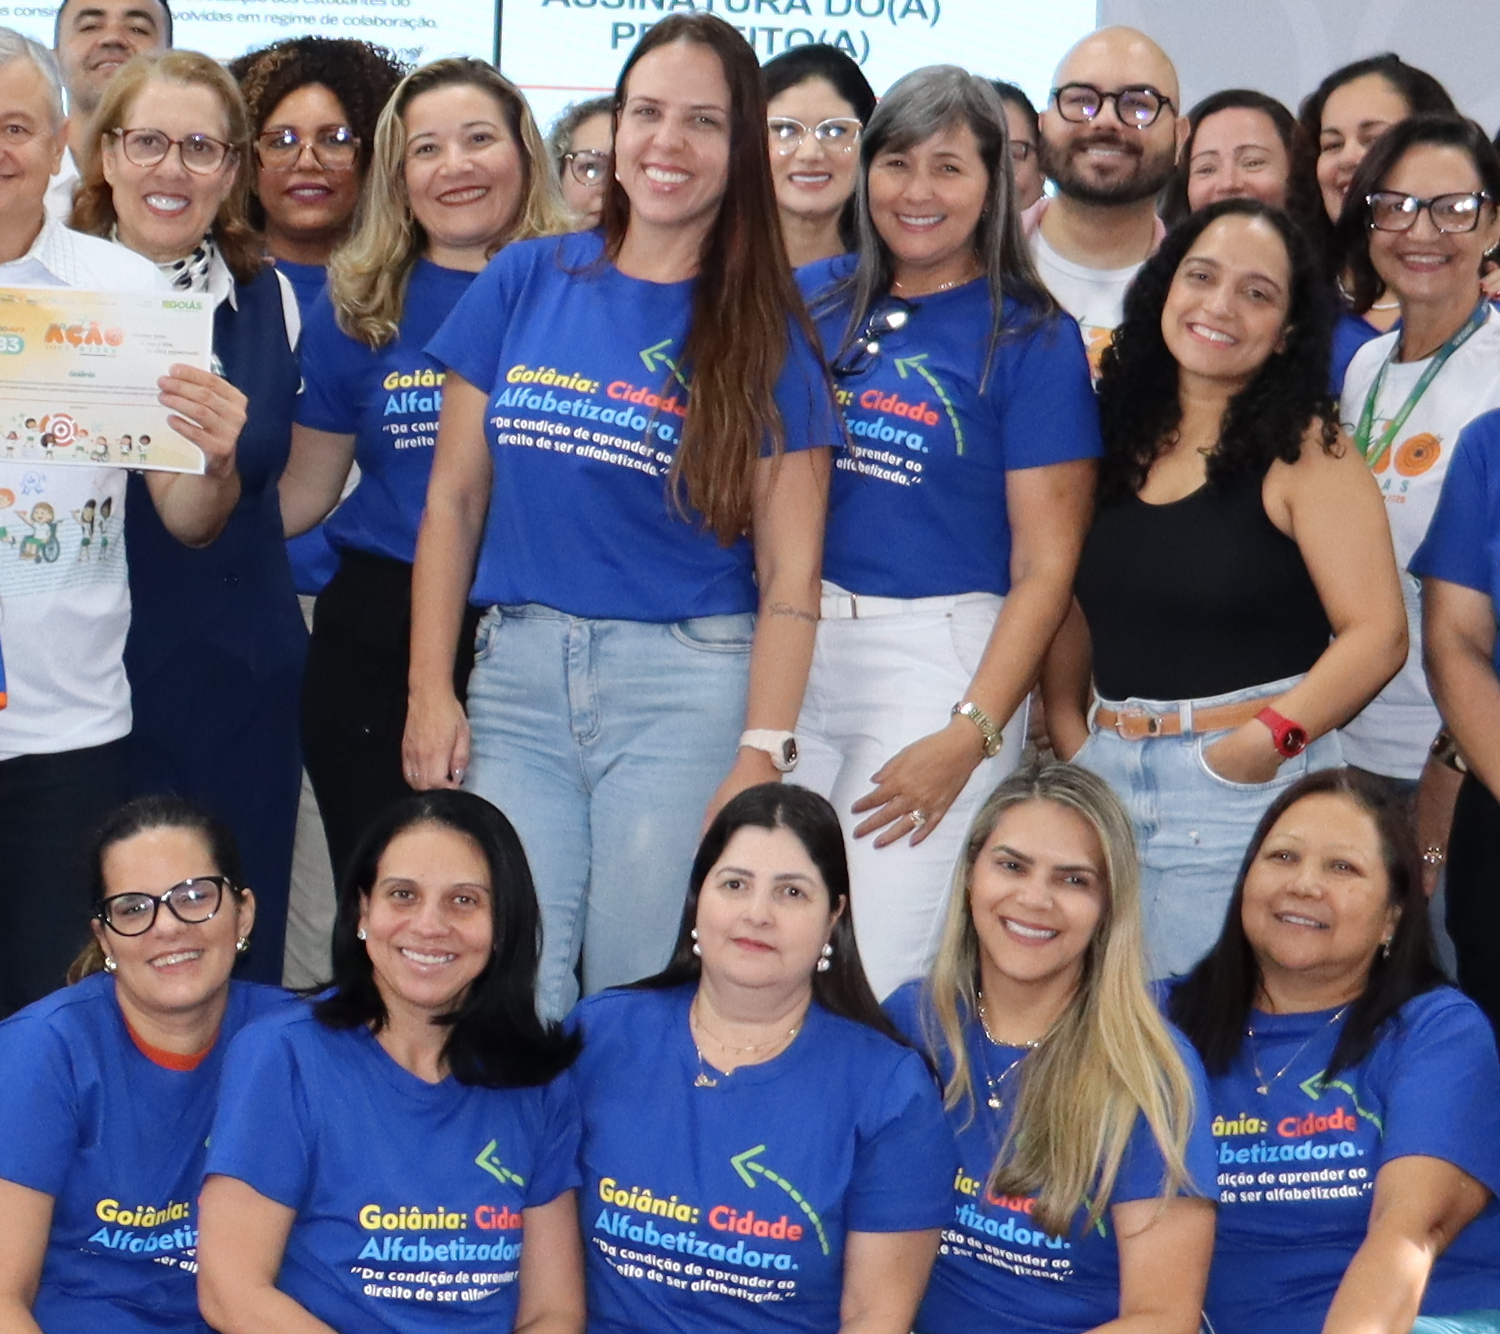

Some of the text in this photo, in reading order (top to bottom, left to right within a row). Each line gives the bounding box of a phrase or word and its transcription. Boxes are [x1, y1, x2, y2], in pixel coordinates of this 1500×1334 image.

[265, 12, 316, 28] regime
[320, 13, 340, 26] de
[505, 365, 600, 394] Goiânia:
[494, 387, 680, 445] Alfabetizadora.
[860, 389, 939, 426] Cidade
[1276, 1108, 1356, 1138] Cidade
[1257, 1167, 1367, 1186] de aprender ao
[599, 1178, 804, 1242] Goiânia: Cidade
[1220, 1189, 1262, 1203] de ser
[96, 1198, 189, 1228] Goiânia:
[359, 1204, 466, 1230] Goiânia:
[594, 1209, 800, 1271] Alfabetizadora.
